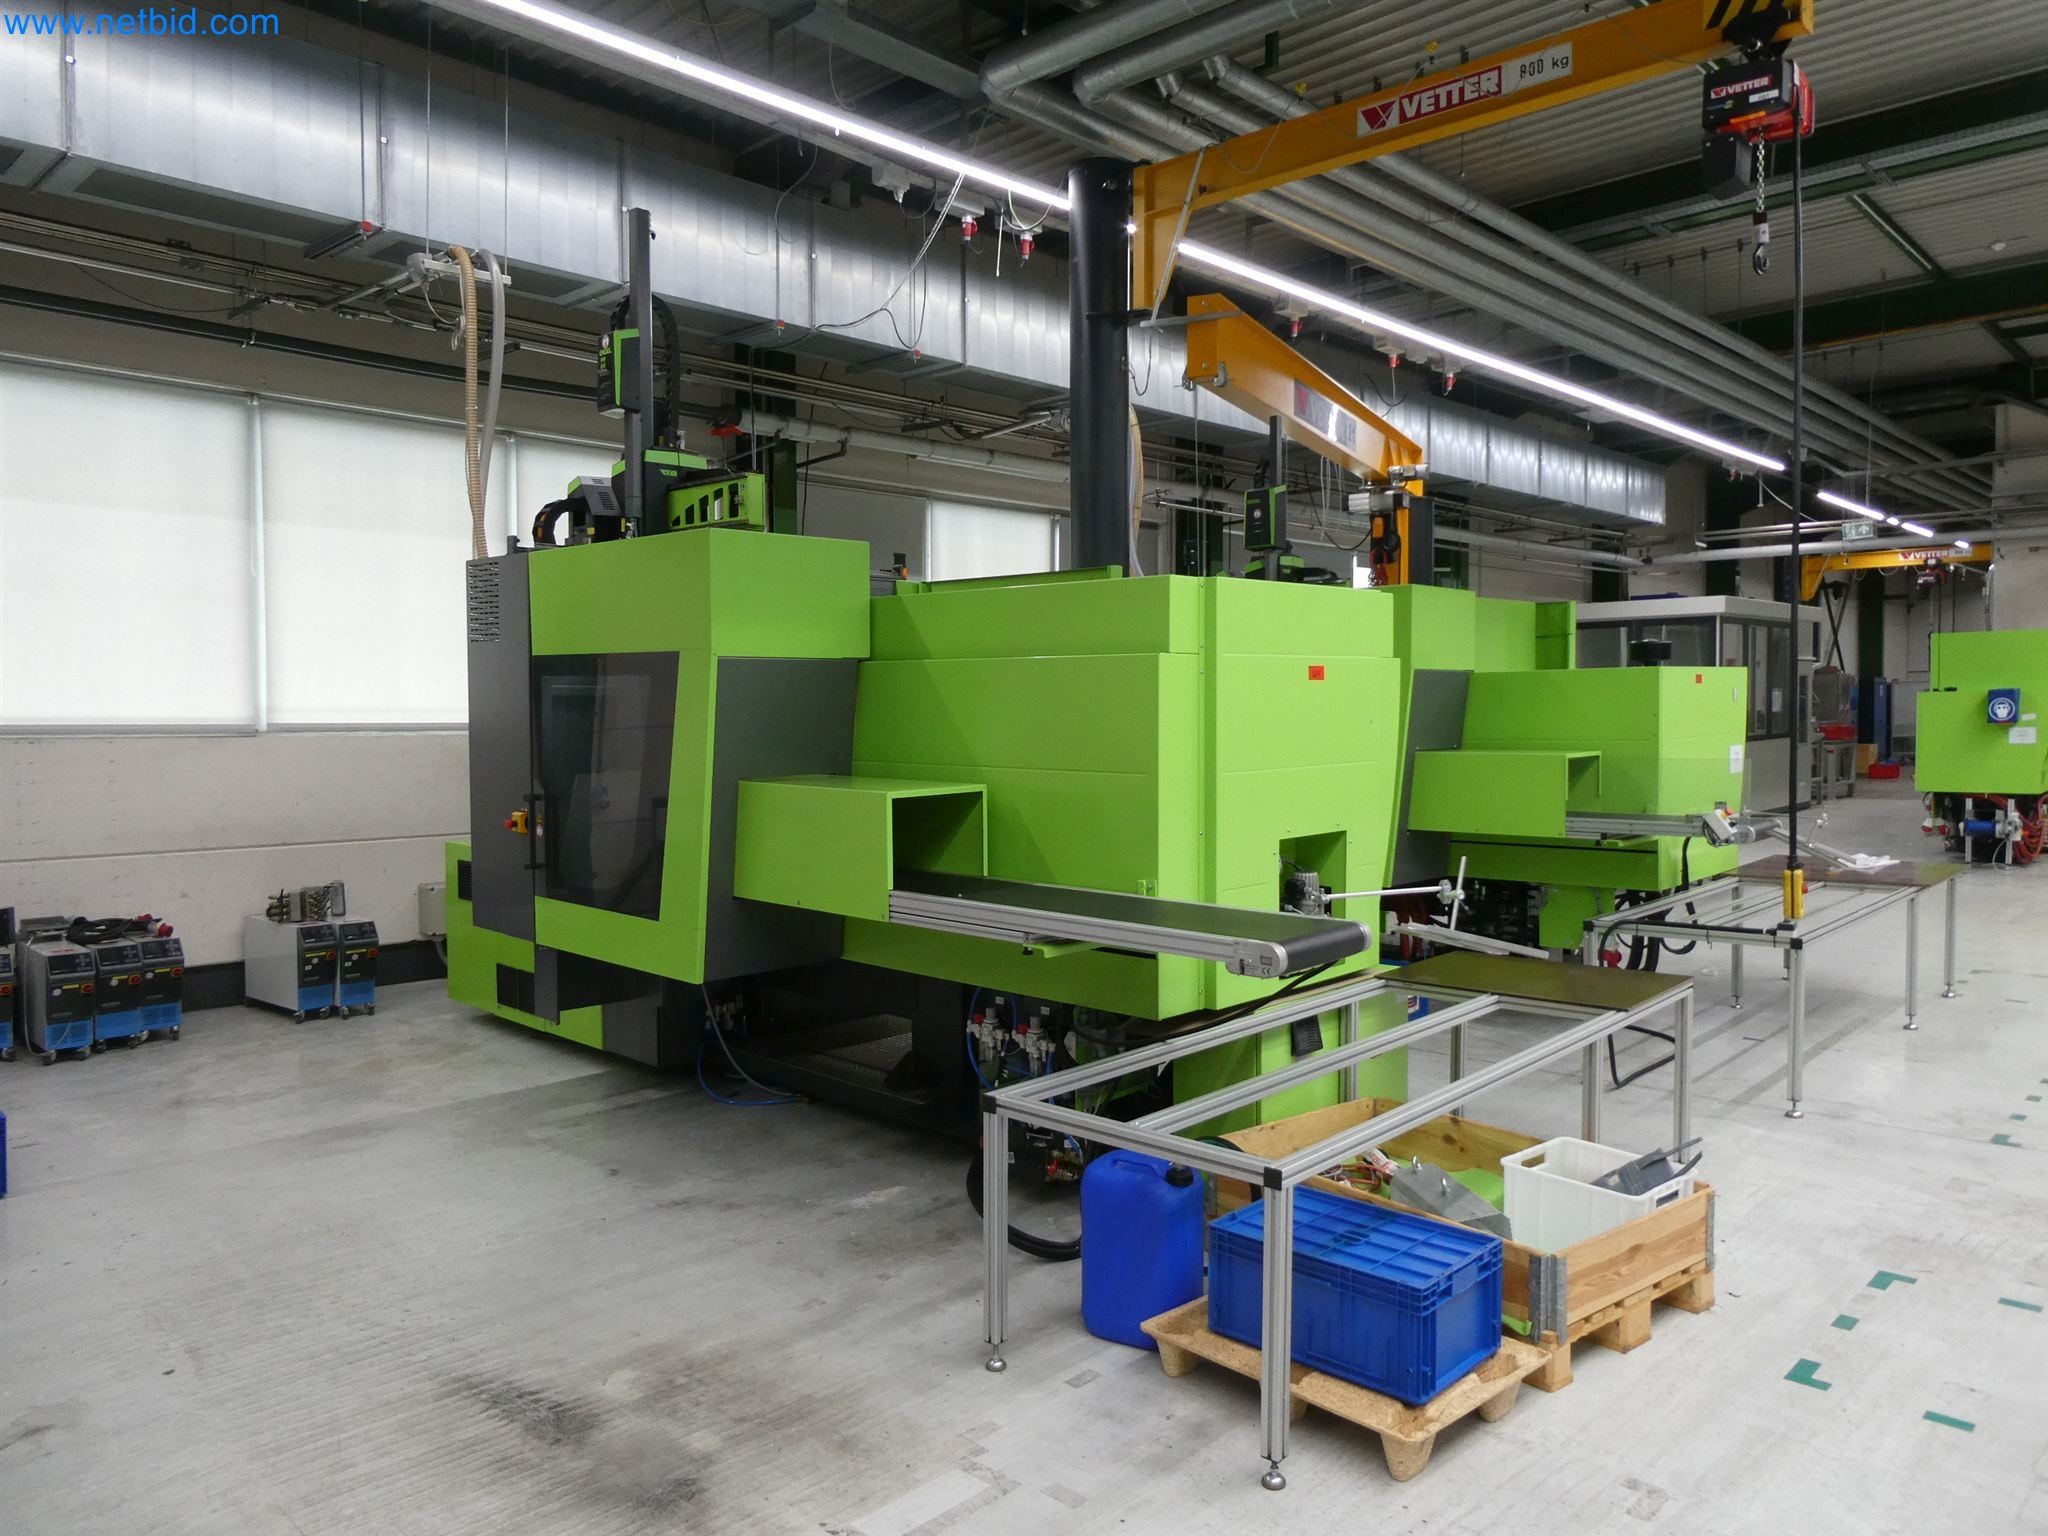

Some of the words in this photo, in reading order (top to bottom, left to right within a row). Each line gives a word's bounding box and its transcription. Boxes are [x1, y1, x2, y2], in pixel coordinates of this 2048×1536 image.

[1401, 68, 1499, 119] VETTER
[1519, 58, 1544, 79] 800
[1551, 54, 1569, 70] kg
[1727, 77, 1769, 94] VETTER
